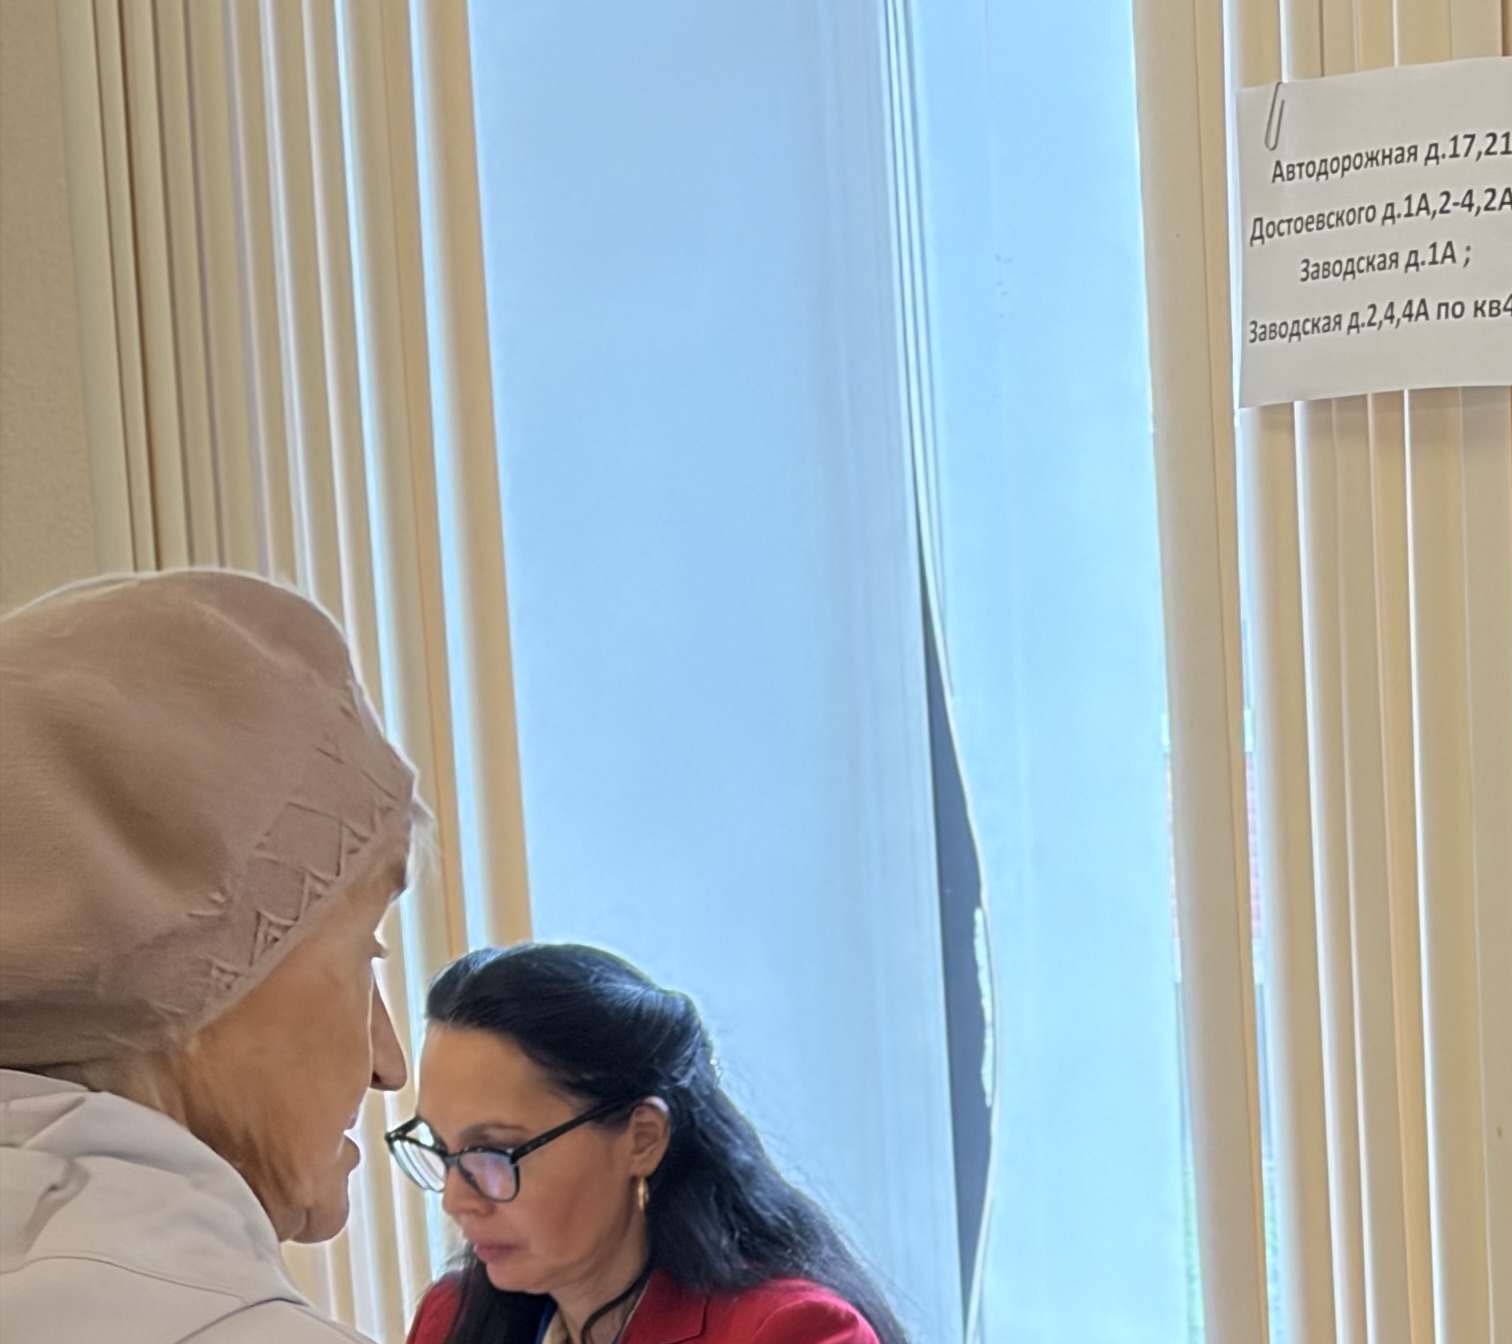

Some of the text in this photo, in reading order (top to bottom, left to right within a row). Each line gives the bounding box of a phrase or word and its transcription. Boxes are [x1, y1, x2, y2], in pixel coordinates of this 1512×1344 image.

[1271, 143, 1418, 183] Автодорожная
[1250, 204, 1377, 246] Достоевского
[1300, 250, 1399, 282] Заводская
[1405, 240, 1456, 273] д.1А
[1248, 313, 1342, 344] Заводская
[1347, 298, 1429, 334] д.2,4,4А
[1436, 301, 1465, 321] по
